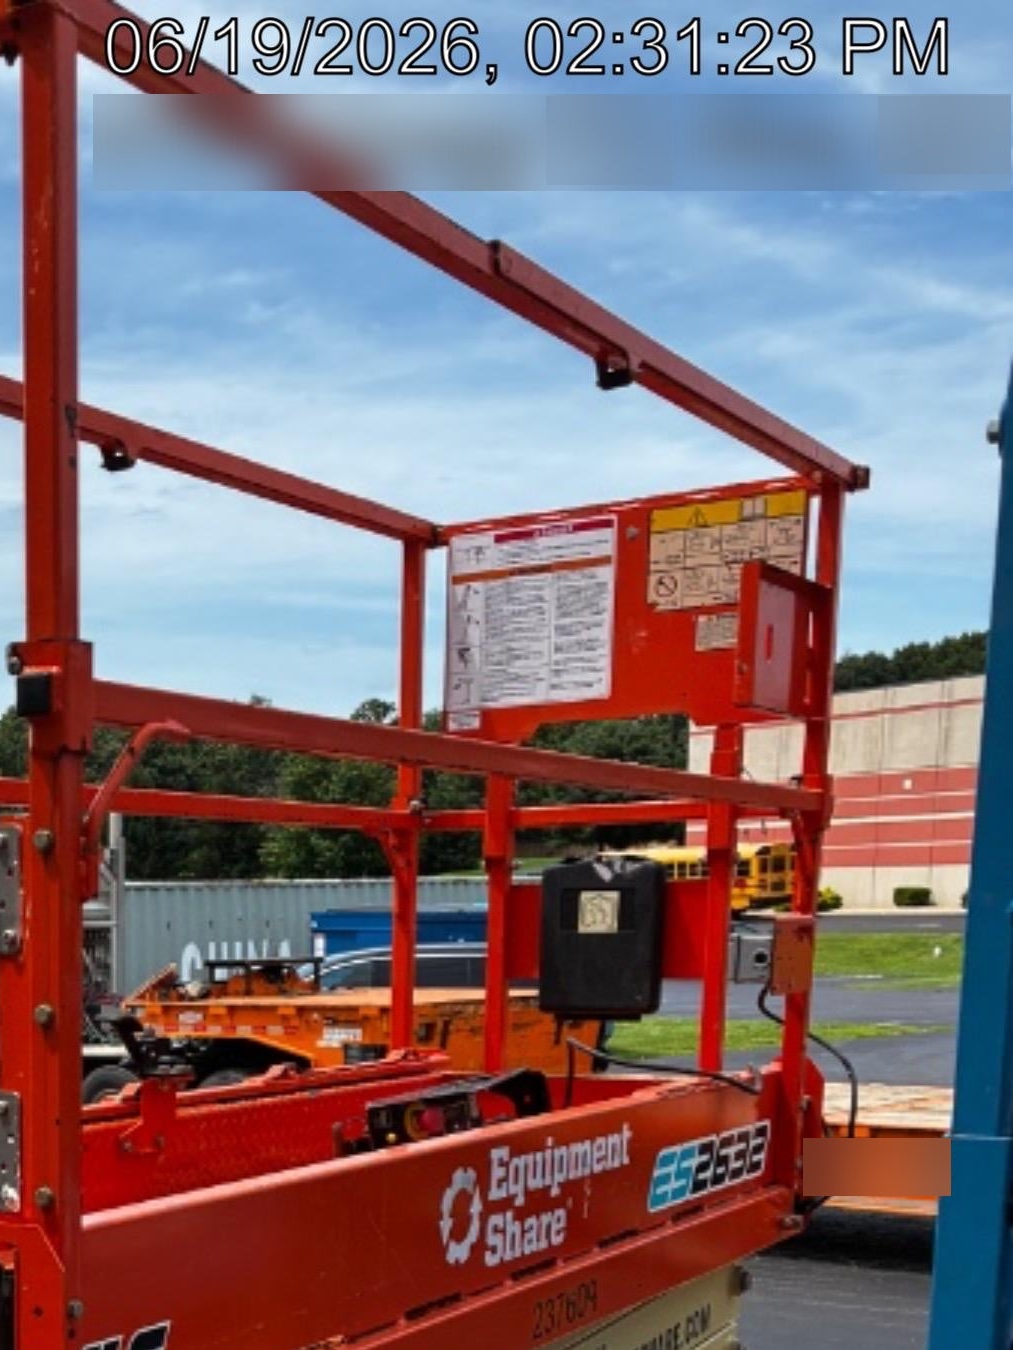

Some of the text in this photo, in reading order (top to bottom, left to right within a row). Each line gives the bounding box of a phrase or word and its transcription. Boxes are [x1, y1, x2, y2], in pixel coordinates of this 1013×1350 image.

[488, 1122, 633, 1206] Equipment
[647, 1119, 772, 1214] ES2632
[485, 1208, 568, 1267] Share
[532, 1279, 599, 1341] 237609
